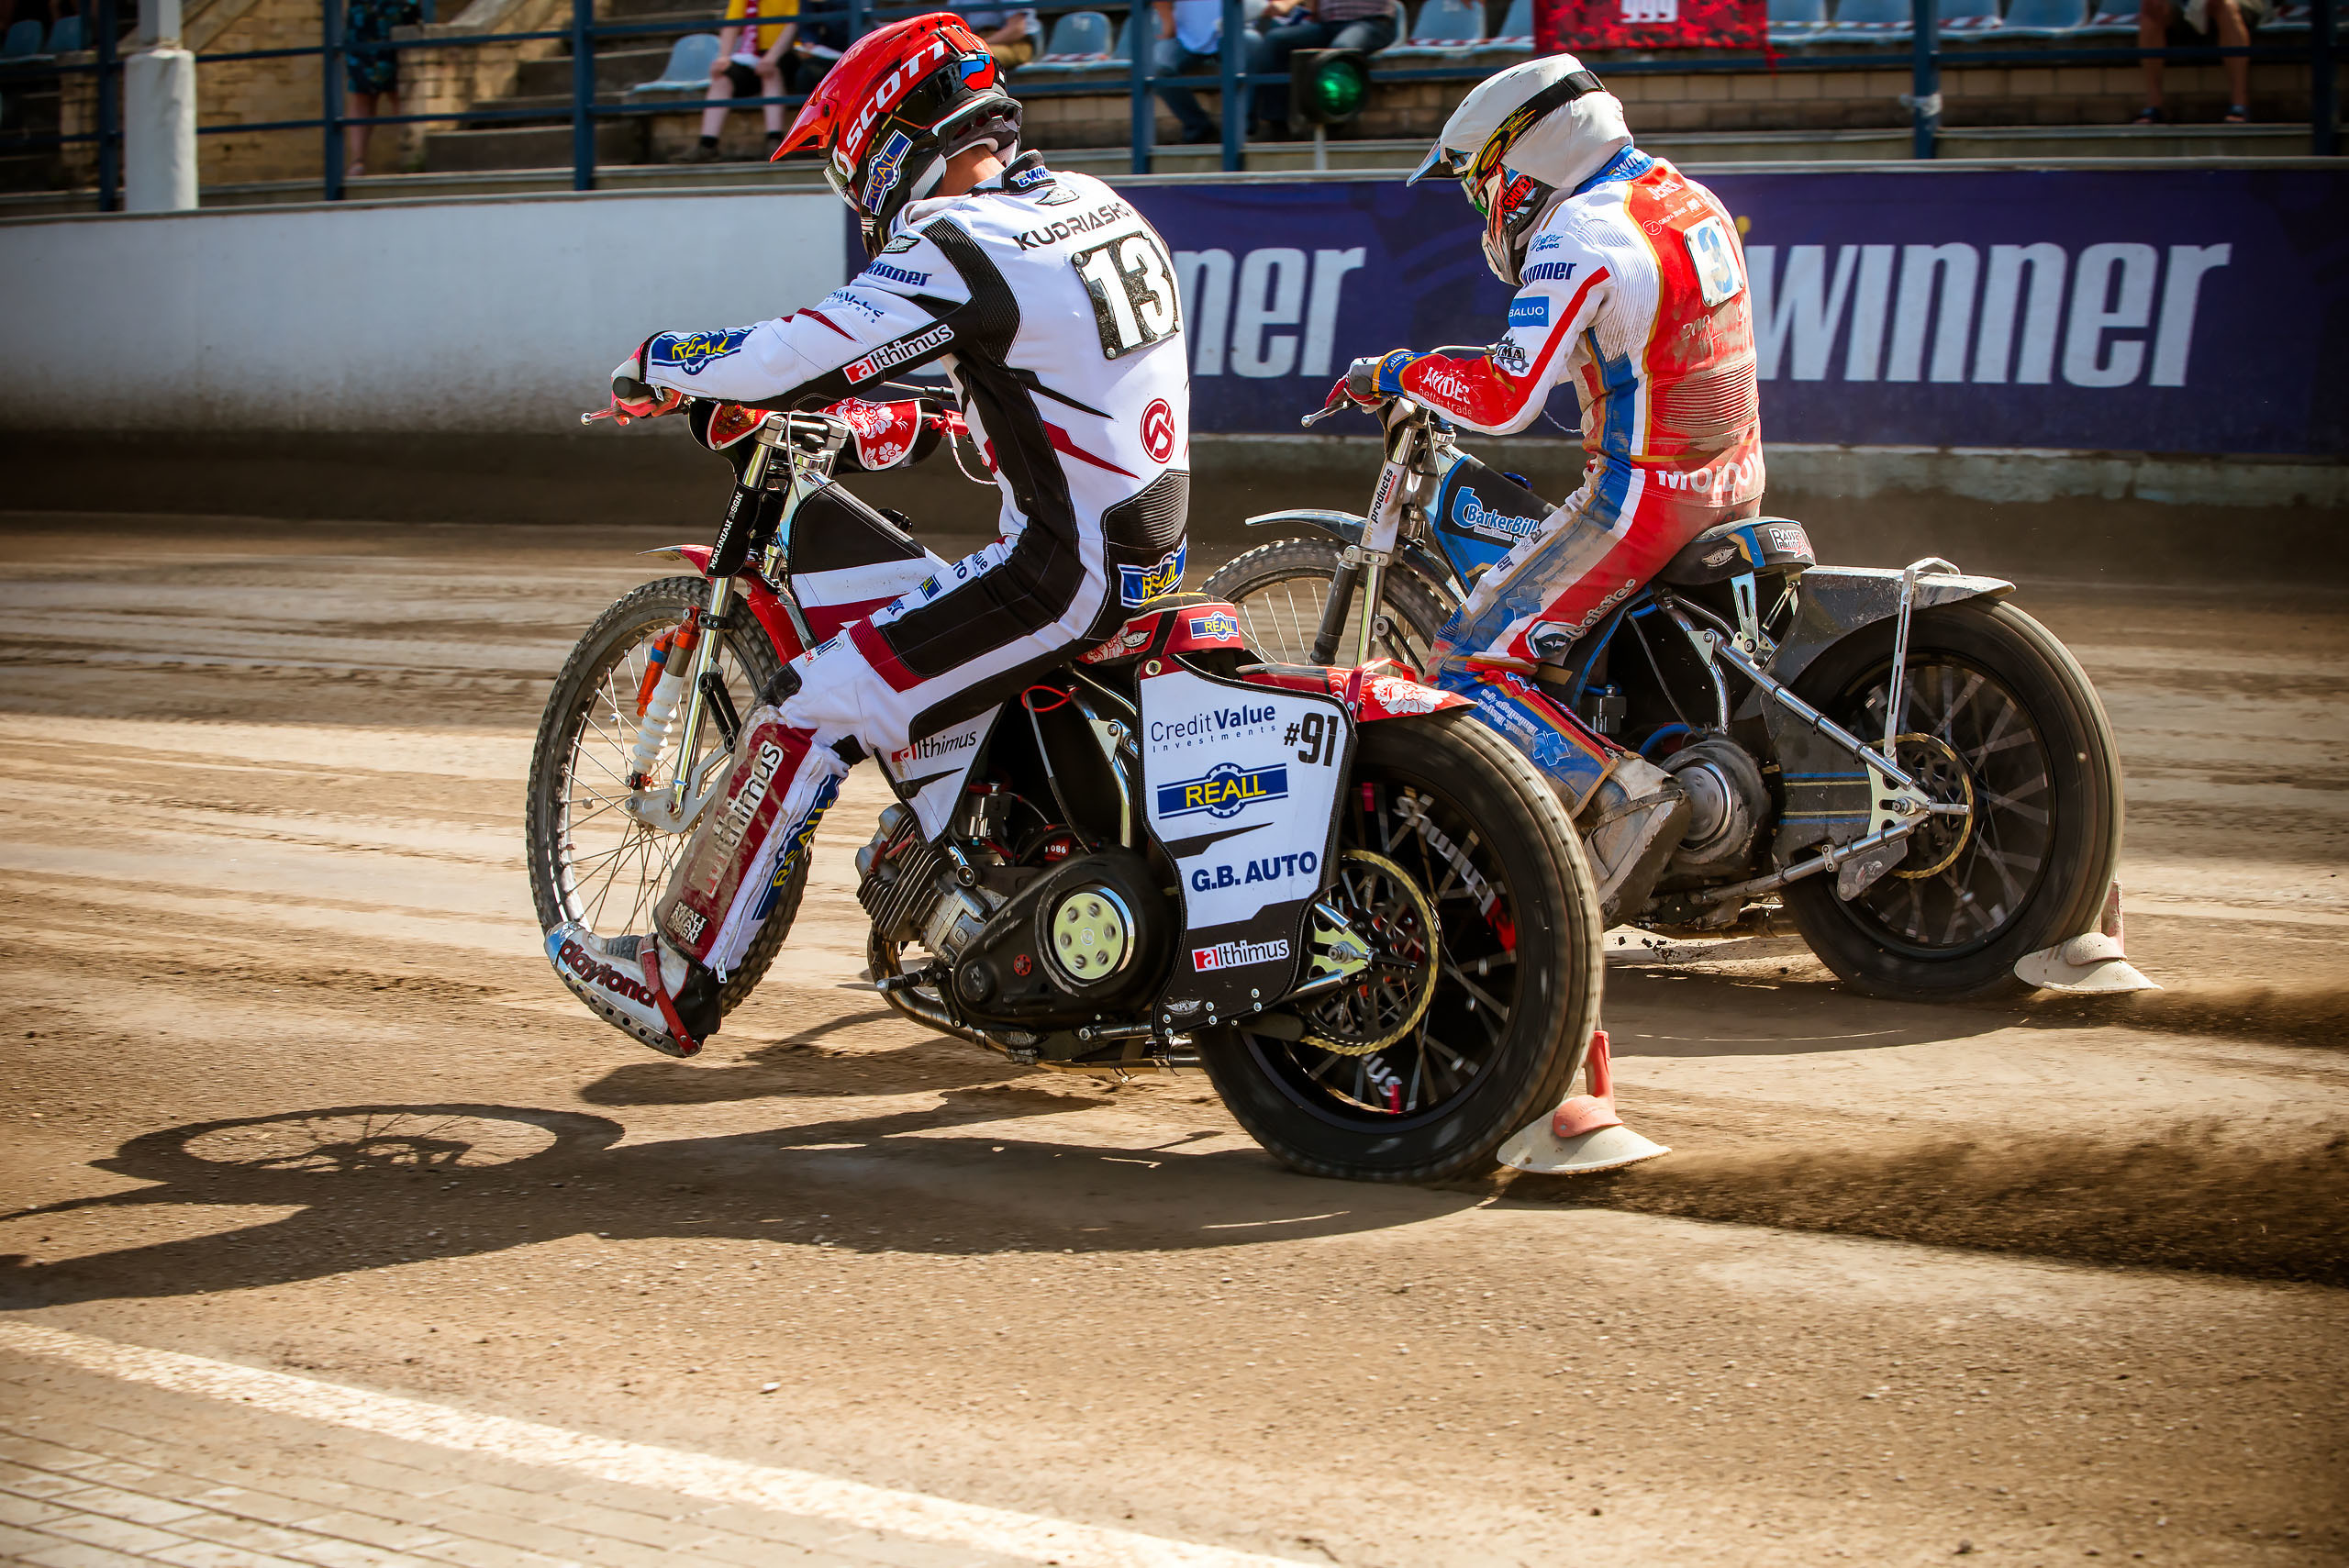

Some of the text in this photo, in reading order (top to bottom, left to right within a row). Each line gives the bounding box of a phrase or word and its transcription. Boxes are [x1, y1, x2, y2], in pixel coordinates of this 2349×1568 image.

[870, 152, 898, 200] REALL
[1504, 174, 1531, 211] SHOEI
[1698, 227, 1733, 294] 3
[1081, 236, 1175, 350] 13
[1508, 306, 1544, 317] BALUO
[1744, 242, 2232, 388] winner
[672, 336, 729, 360] REAL
[854, 324, 954, 379] althimus
[1419, 384, 1472, 418] better trade
[1384, 473, 1397, 505] denmark
[1204, 620, 1234, 633] REALL
[1152, 725, 1276, 753] Investments
[1284, 712, 1340, 767] #91
[710, 740, 785, 861] thimus
[1185, 774, 1267, 808] REALL
[1191, 851, 1318, 893] G.B. AUTO
[1201, 940, 1289, 968] althimus
[559, 939, 657, 1009] daytona
